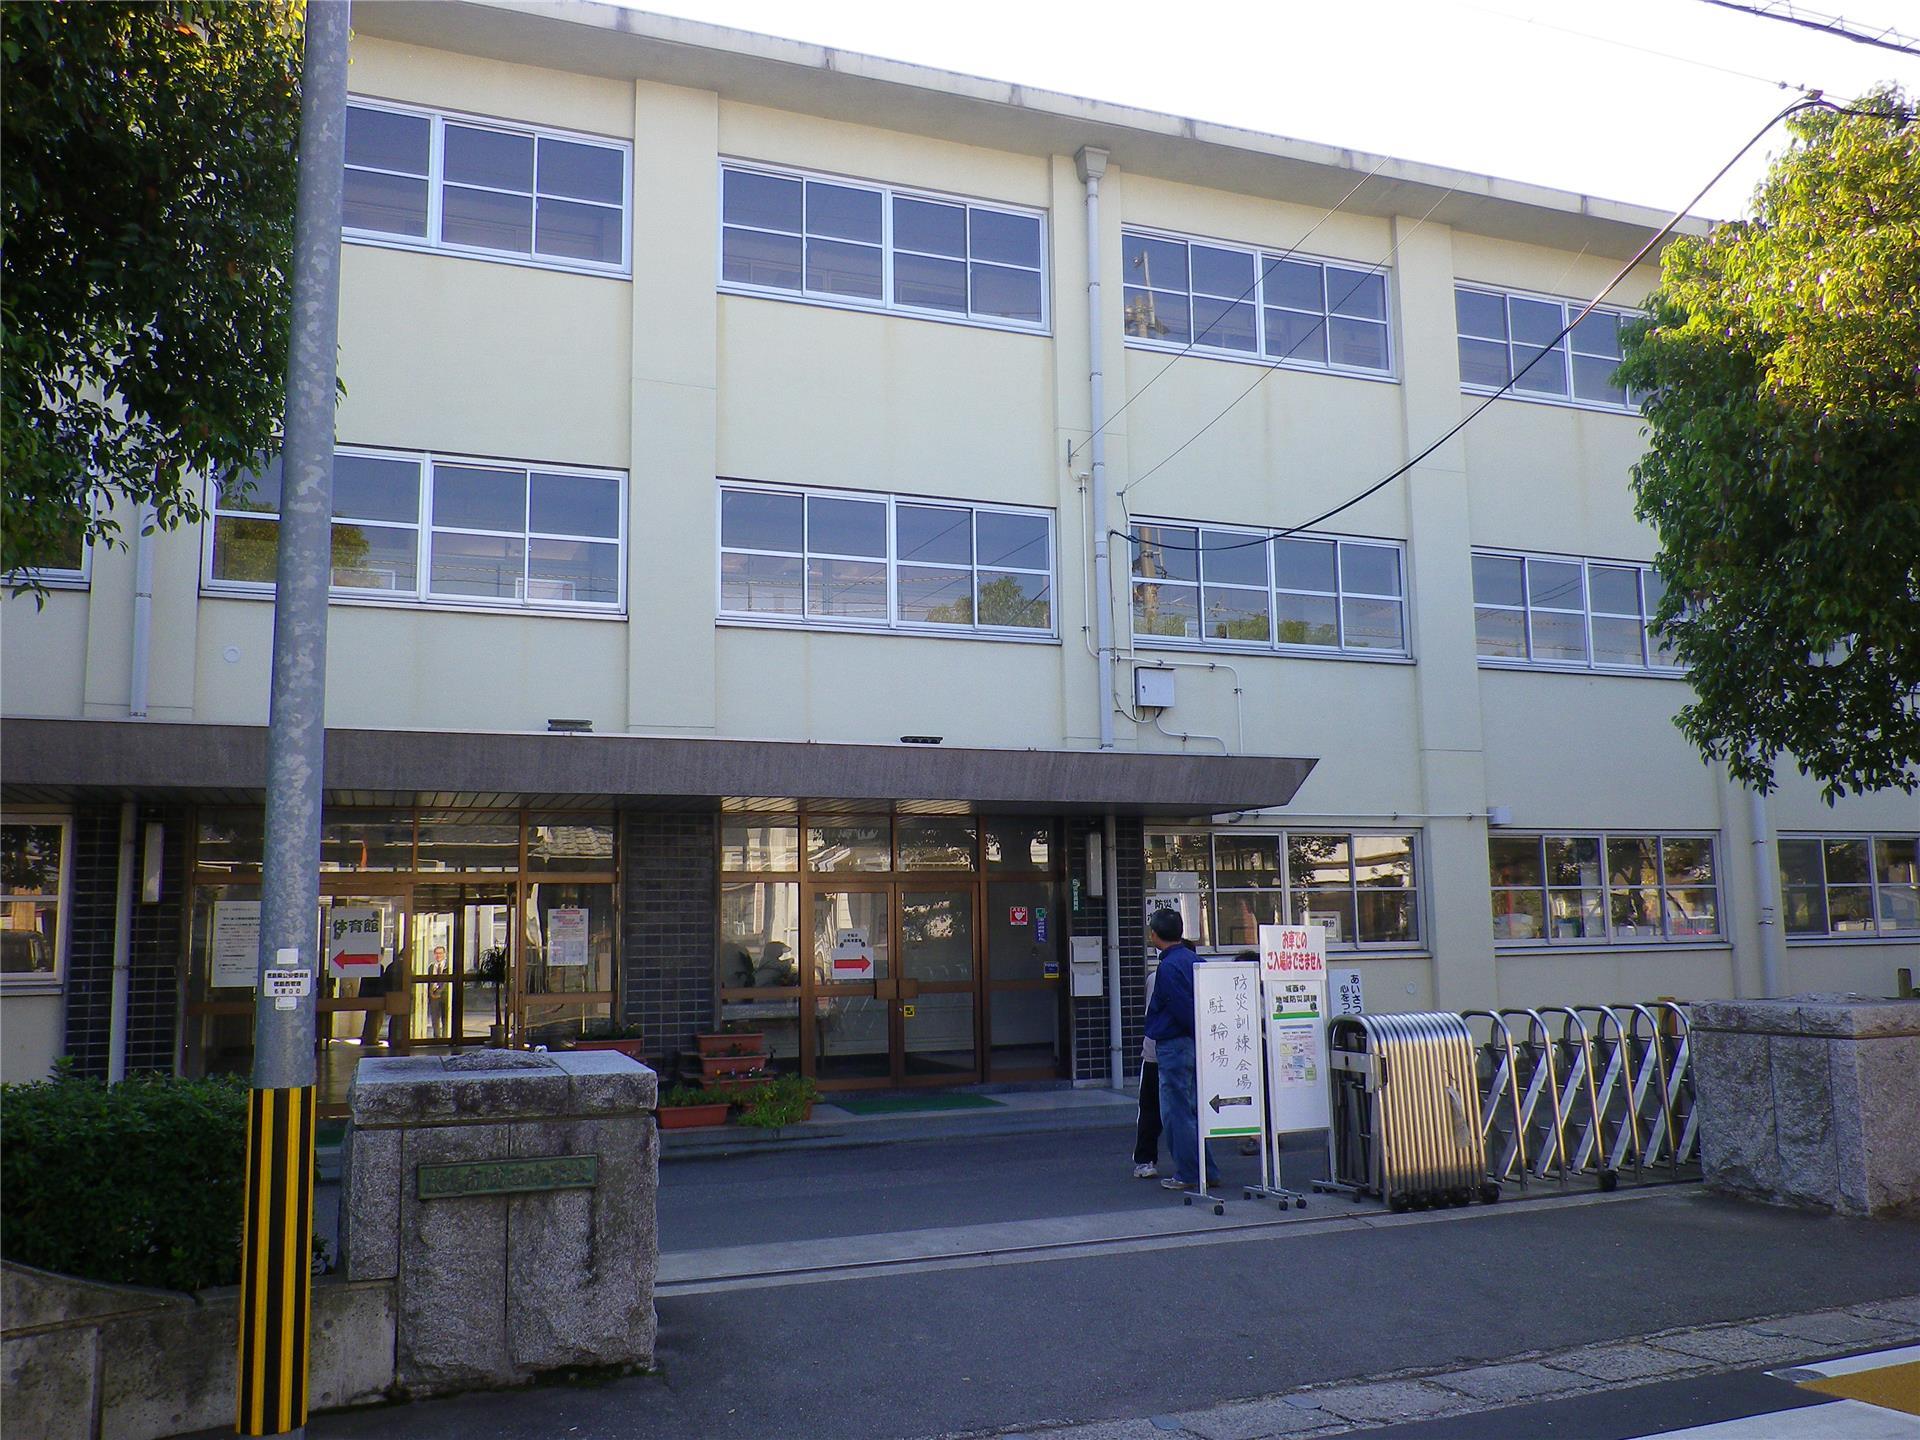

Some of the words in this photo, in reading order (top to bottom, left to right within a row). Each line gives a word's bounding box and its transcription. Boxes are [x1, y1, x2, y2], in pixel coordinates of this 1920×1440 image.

[333, 919, 379, 933] 体育館
[1282, 930, 1307, 949] お車での
[1207, 996, 1229, 1068] 駐輪場
[1233, 974, 1252, 1090] 防災訓練会場
